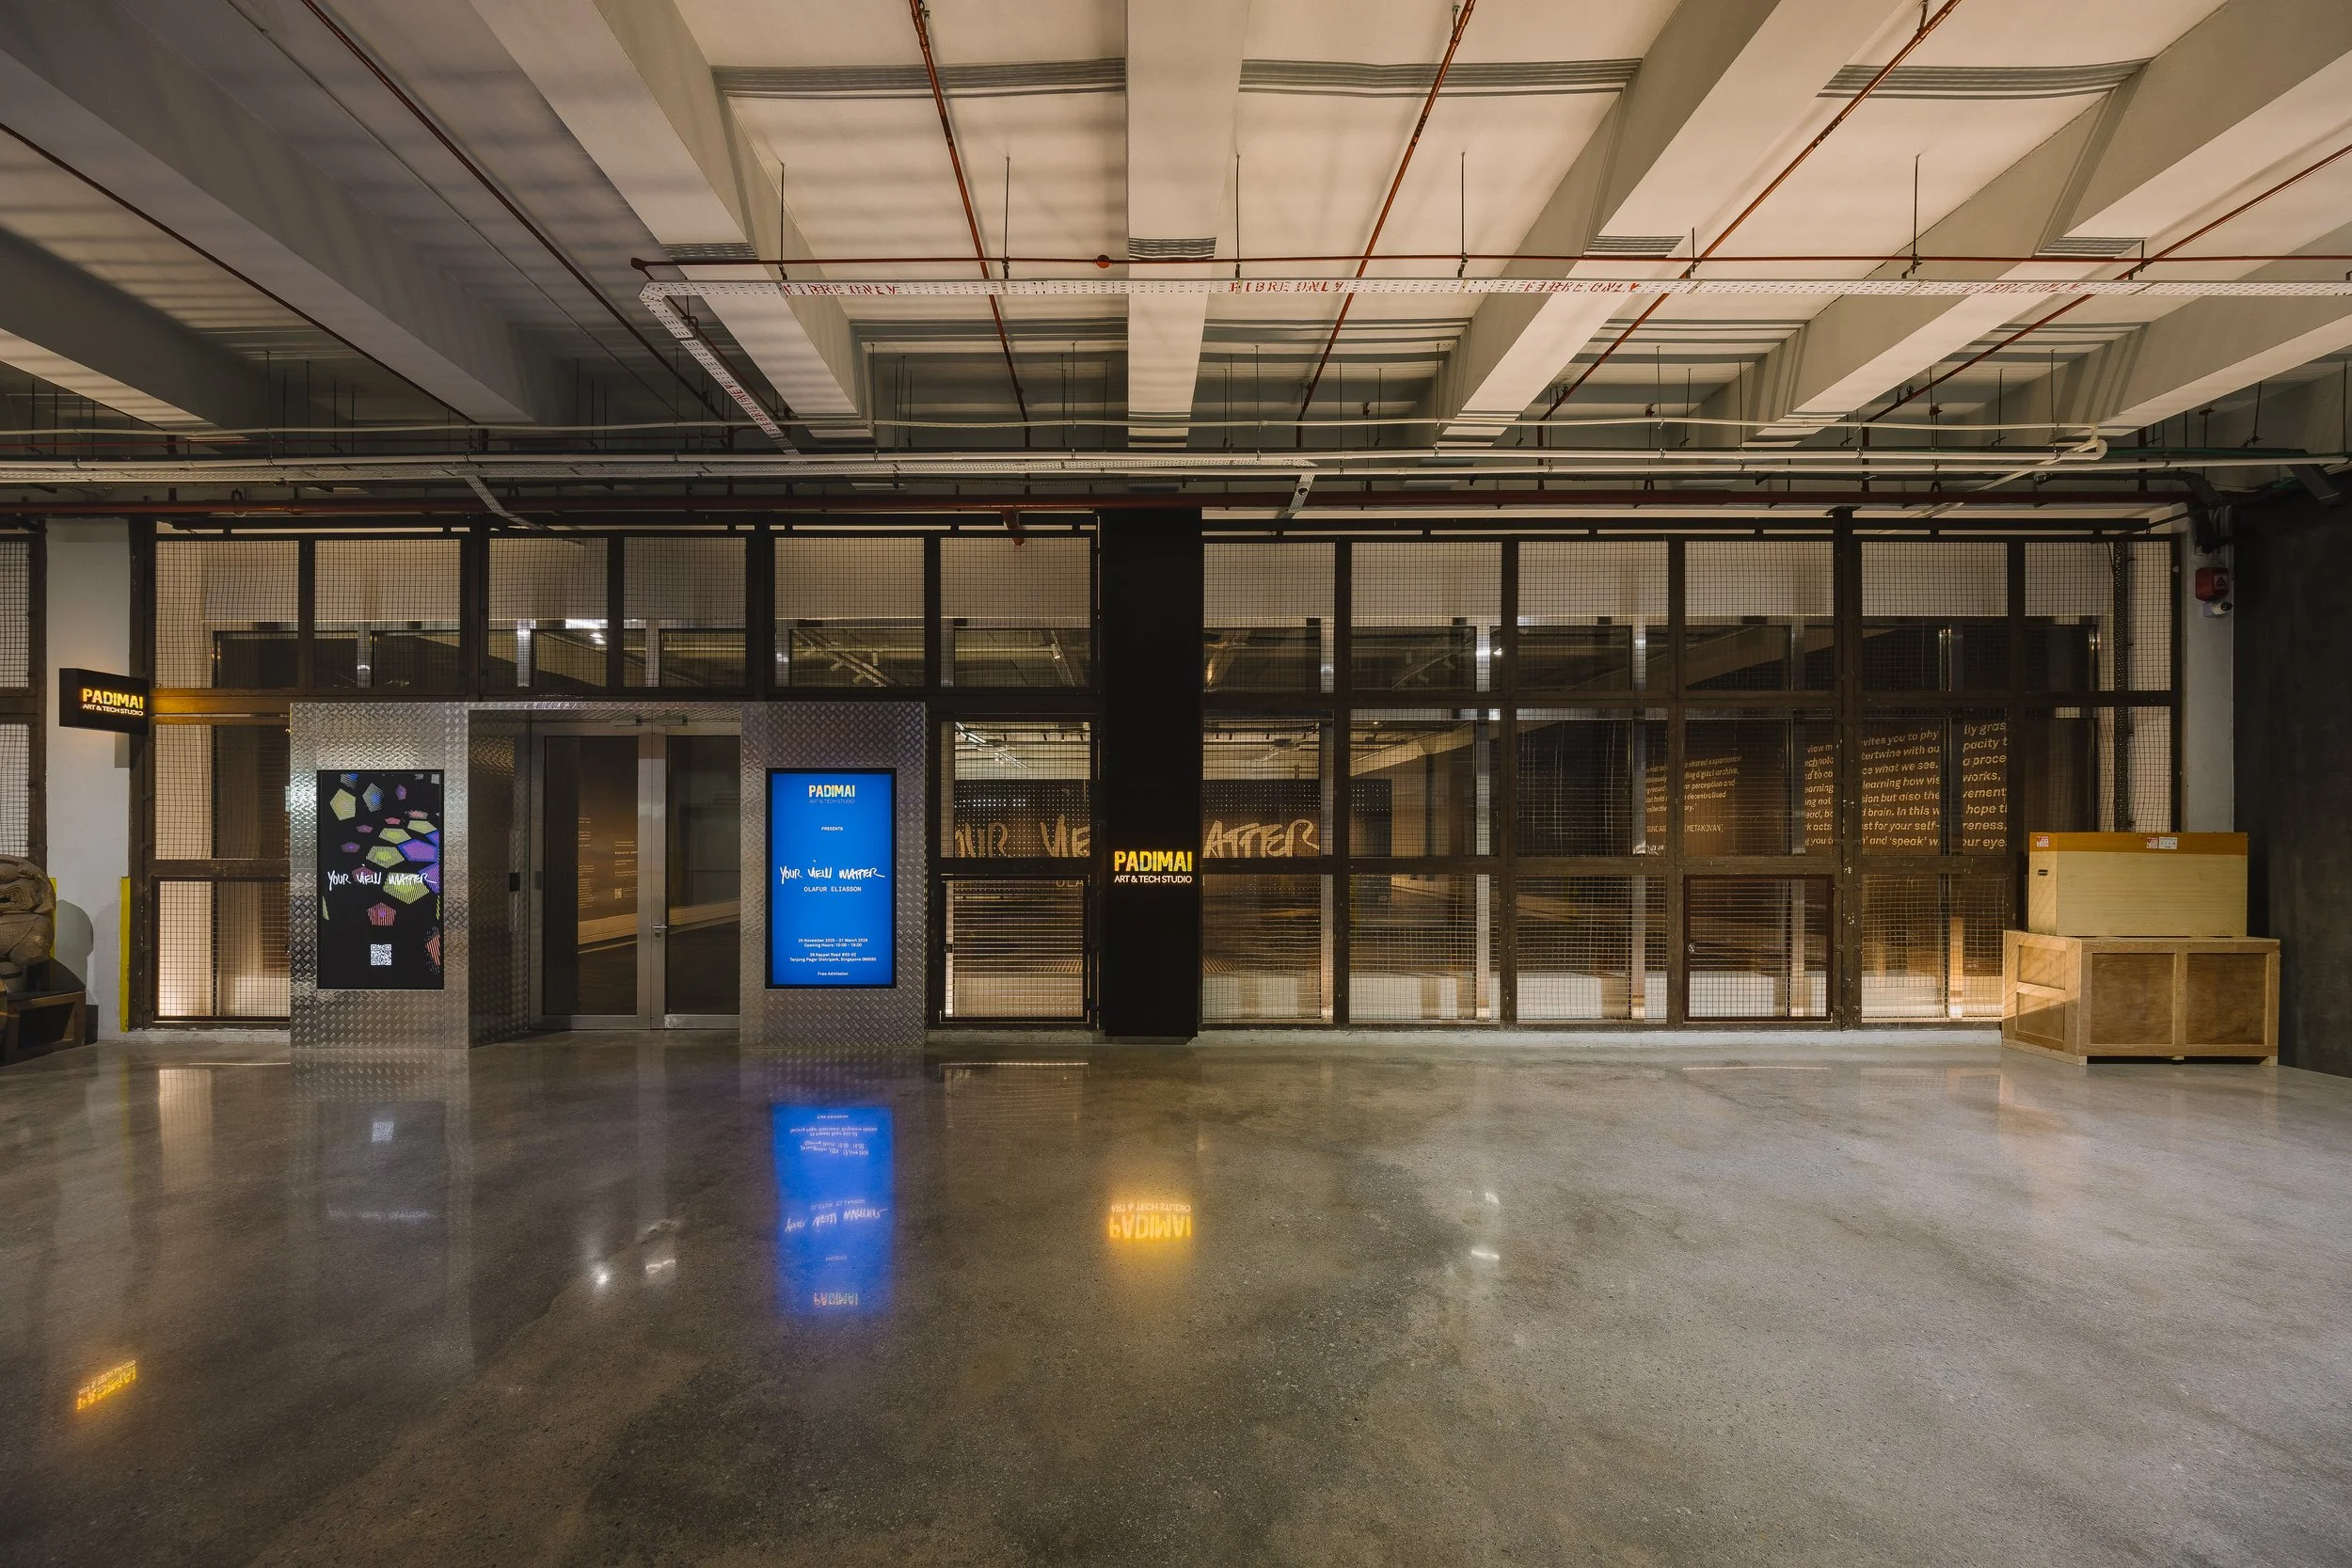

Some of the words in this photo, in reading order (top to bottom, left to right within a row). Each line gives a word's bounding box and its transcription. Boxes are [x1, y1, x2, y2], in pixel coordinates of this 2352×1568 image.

[82, 689, 144, 709] PADIMAI
[1886, 735, 1905, 746] you
[1907, 733, 1918, 741] to
[1903, 746, 1925, 756] with
[1963, 737, 1999, 752] pacity
[1874, 763, 1899, 774] what
[1901, 762, 1915, 771] we
[1917, 761, 1938, 770] see.
[1863, 778, 1901, 789] learning
[1902, 777, 1924, 786] how
[808, 784, 855, 798] PADIMAI
[1881, 793, 1898, 802] but
[1899, 792, 1921, 801] also
[1923, 790, 1940, 800] the
[1867, 807, 1895, 816] brain.
[1897, 807, 1906, 816] In
[1908, 806, 1930, 816] this
[1965, 804, 1996, 816] hope
[1813, 822, 1833, 831] acts
[1874, 821, 1888, 831] for
[1888, 823, 1912, 832] your
[1869, 835, 1887, 845] and
[1114, 850, 1193, 872] PADIMAI
[327, 870, 351, 891] YOUR
[780, 865, 803, 884] YOUR
[1114, 875, 1130, 883] ART
[1131, 875, 1137, 883] &
[1138, 875, 1161, 883] TECH
[1162, 875, 1192, 883] STUDIO
